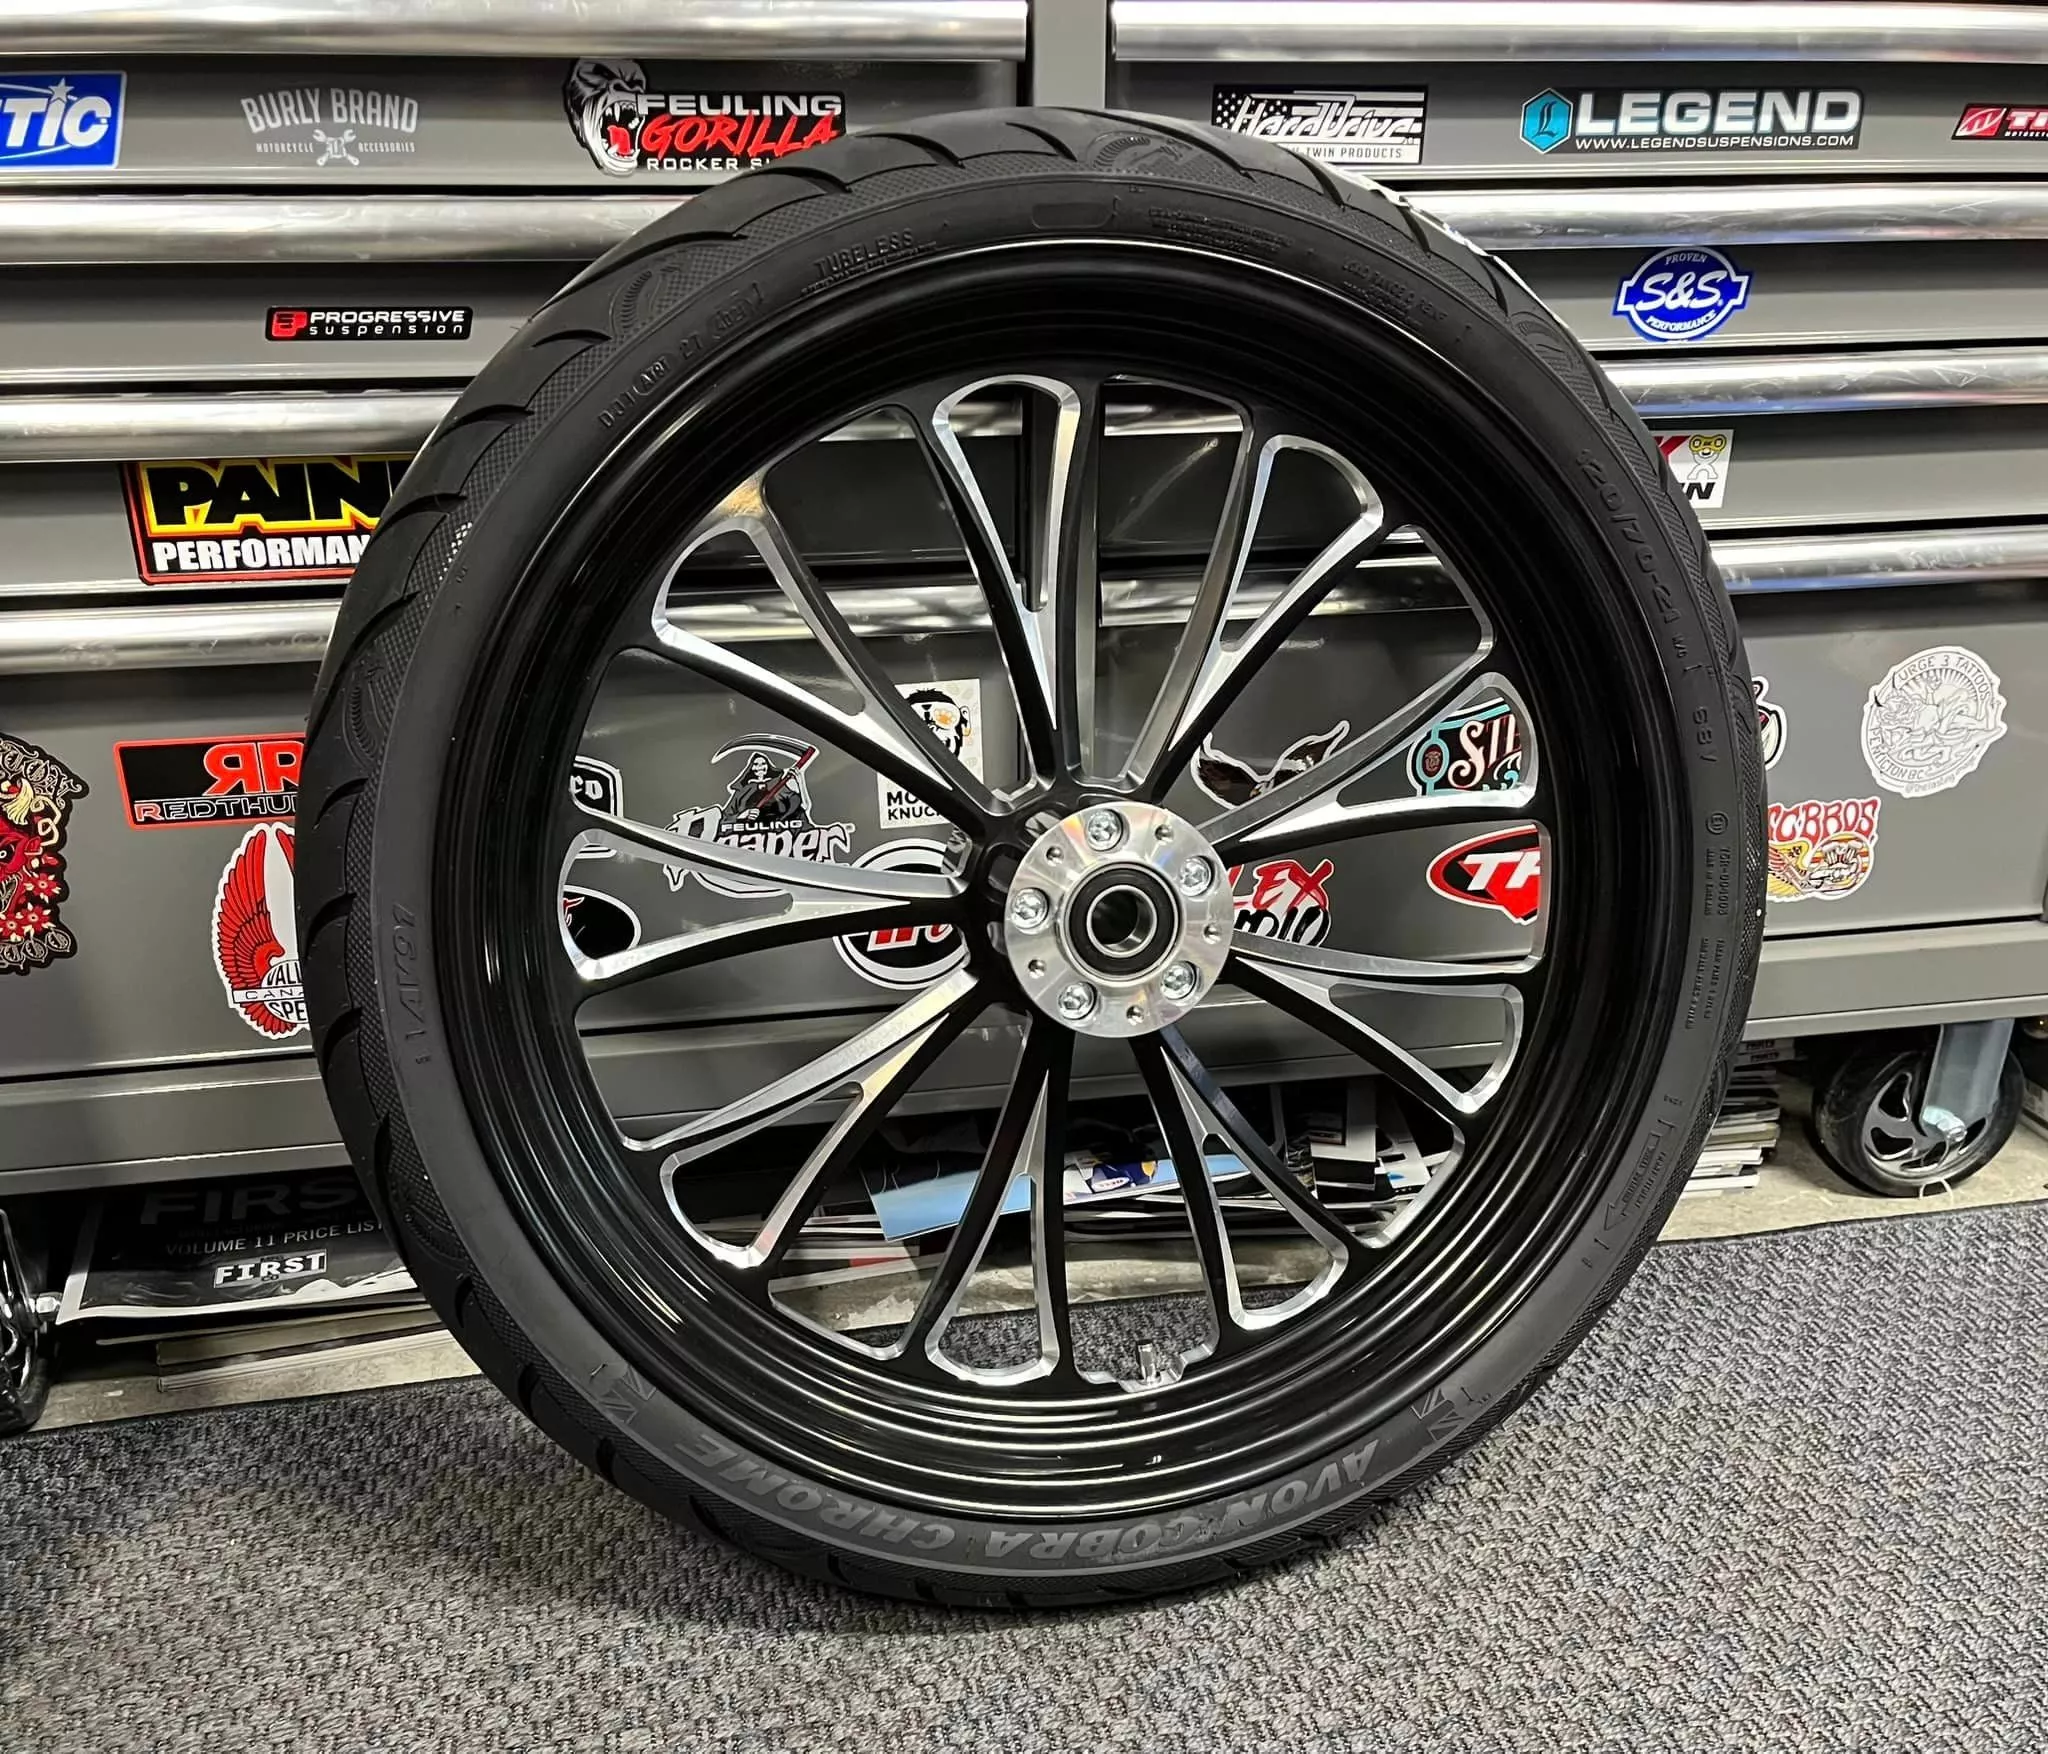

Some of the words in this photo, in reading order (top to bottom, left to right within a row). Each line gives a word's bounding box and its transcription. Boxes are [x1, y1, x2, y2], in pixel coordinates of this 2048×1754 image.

[241, 88, 321, 134] BURLY
[330, 87, 419, 134] BRAND
[638, 94, 842, 117] FEULING
[1576, 90, 1860, 135] LEGEND
[0, 96, 112, 147] TIC
[641, 109, 840, 160] GORILLA
[256, 142, 314, 153] MOTORCYCLE
[358, 142, 416, 153] ACCESSORIES
[1340, 147, 1402, 158] PRODUCTS
[1575, 135, 1855, 150] WWW.LEGENDSUSPENSIONS.COM
[647, 157, 740, 170] ROCKER
[812, 228, 915, 281] TUBELESS
[1665, 252, 1708, 265] PROVEN
[309, 324, 463, 337] suspension
[310, 310, 465, 324] PROGRESSIVE
[1646, 309, 1718, 332] PERFORMANCE
[146, 460, 404, 526] PAIN
[152, 534, 371, 572] PERFORMAN
[721, 820, 803, 832] FEULING
[887, 806, 940, 820] KNUC
[165, 1238, 247, 1256] VOLUME
[254, 1235, 275, 1248] 11
[283, 1226, 341, 1245] PRICE
[347, 1220, 384, 1235] LIST
[215, 1252, 326, 1285] FIRST
[675, 1433, 955, 1550] CHROME
[1217, 1439, 1379, 1530] AVON
[985, 1516, 1201, 1561] COBRA
